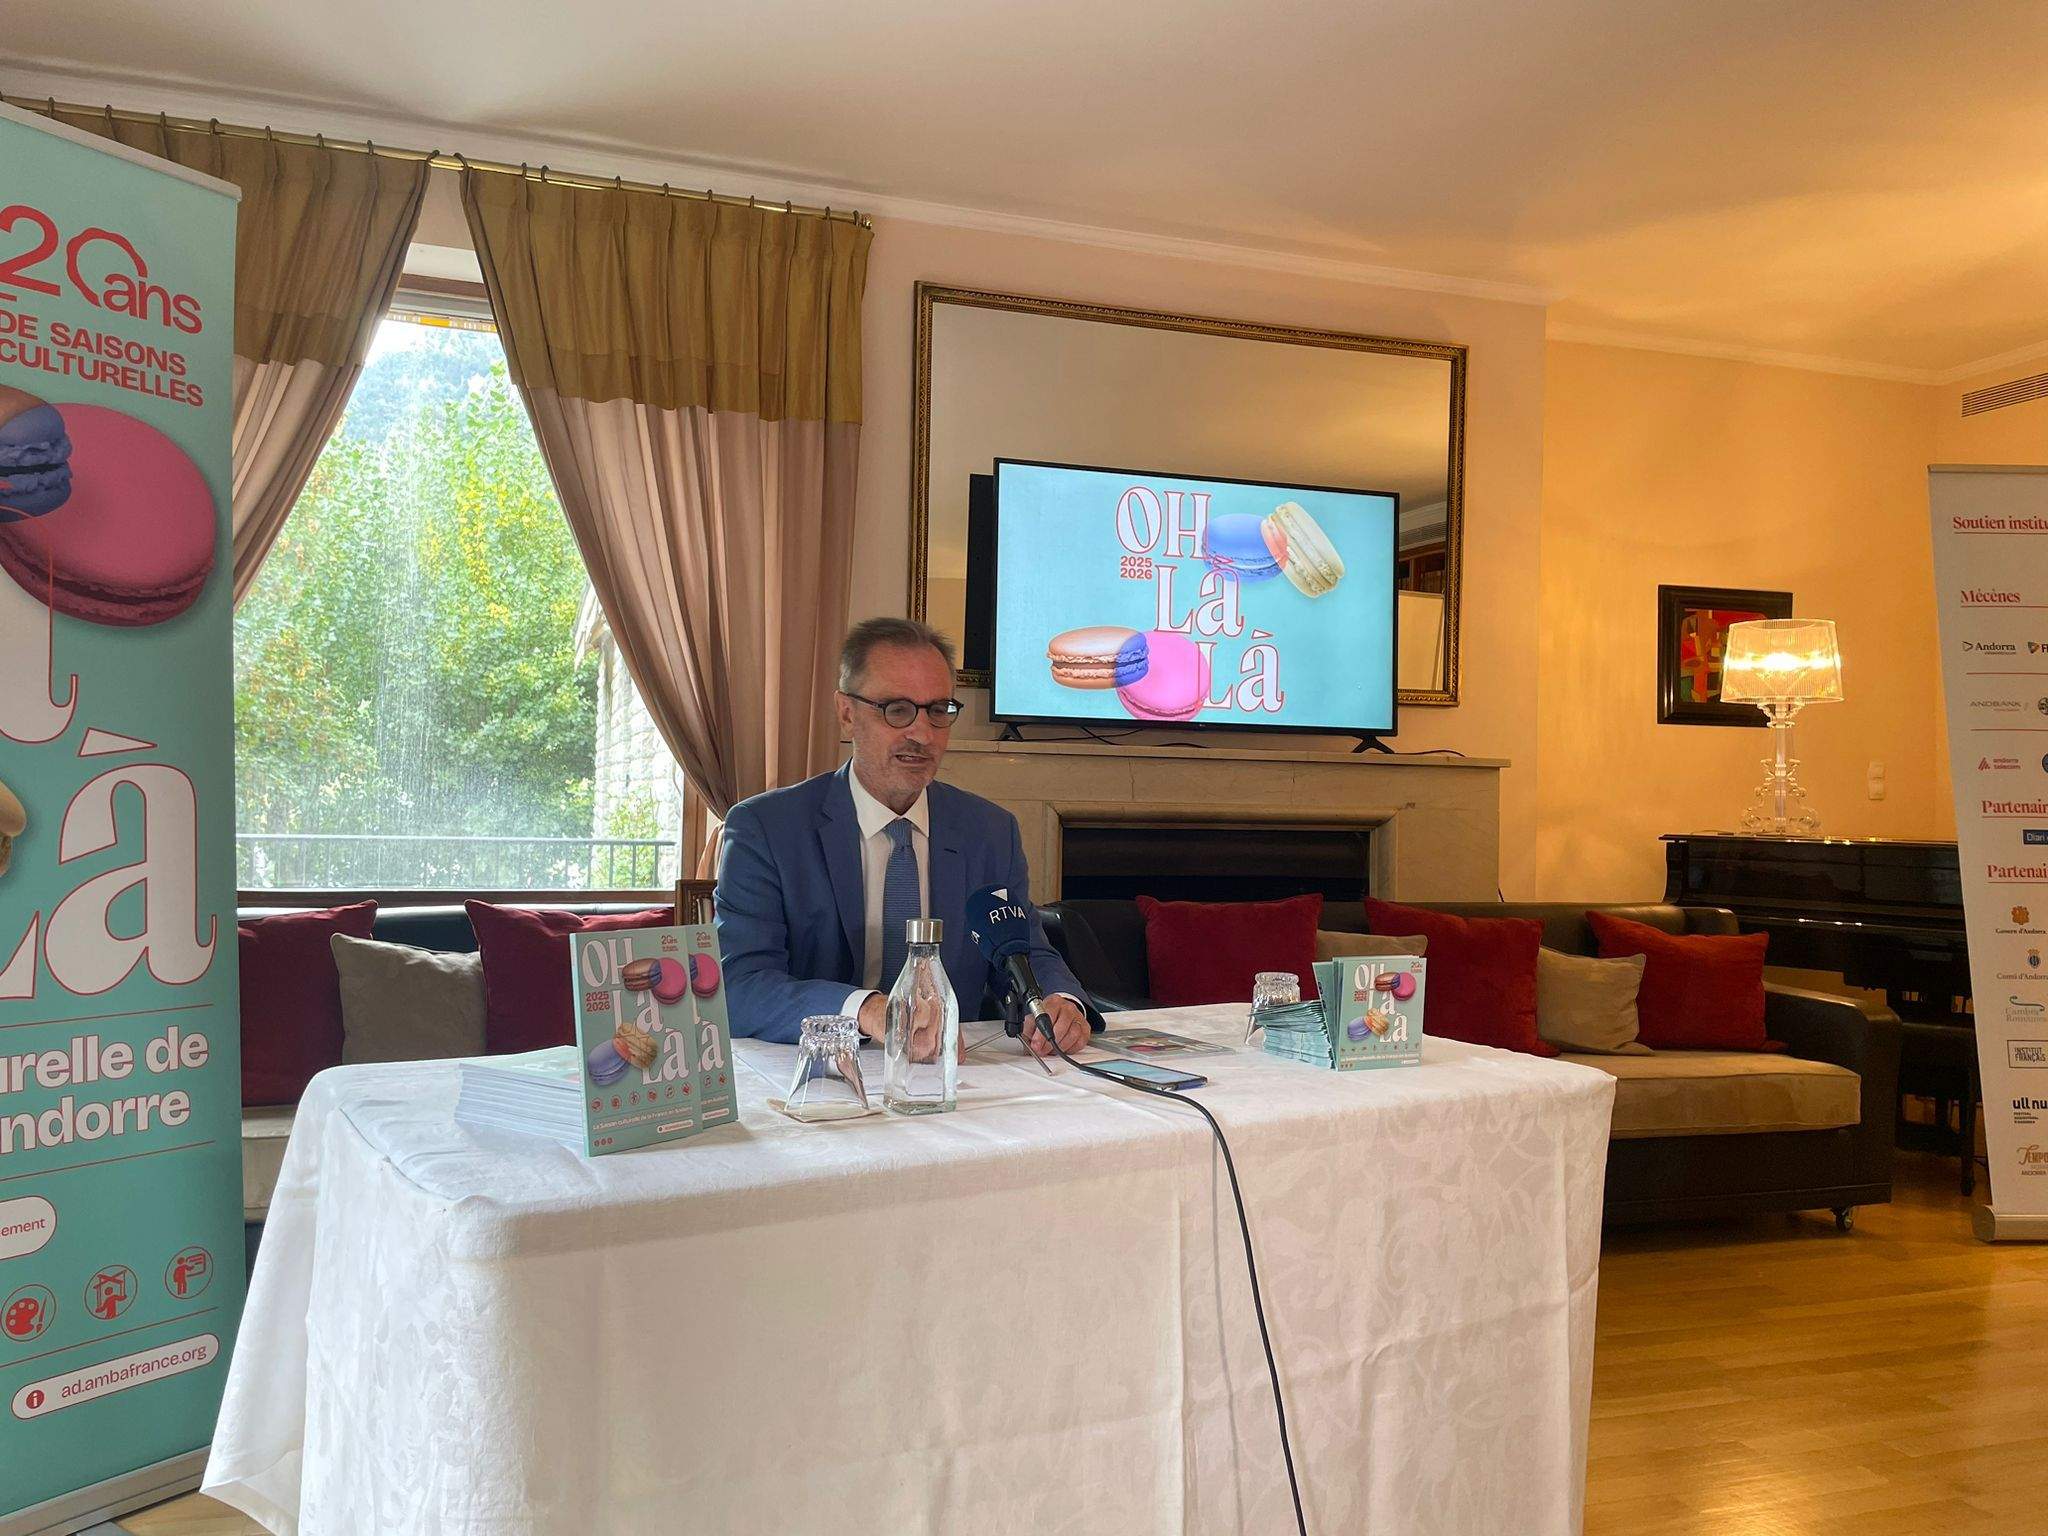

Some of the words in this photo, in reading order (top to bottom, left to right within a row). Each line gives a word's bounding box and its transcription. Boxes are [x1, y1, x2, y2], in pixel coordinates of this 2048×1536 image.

[50, 322, 187, 376] SAISONS
[0, 338, 203, 407] CULTURELLES
[1116, 486, 1212, 559] OH
[1953, 516, 2006, 529] Soutien
[1120, 556, 1153, 568] 2025
[1120, 567, 1153, 580] 2026
[1961, 588, 2020, 603] Mécènes
[1976, 642, 2016, 651] Andorra
[989, 906, 1026, 924] RTVA
[586, 991, 609, 1002] 2025
[145, 1025, 209, 1074] de
[2013, 1097, 2031, 1109] ull
[1, 1218, 46, 1237] ement
[61, 1345, 207, 1398] ad.ambafrance.org
